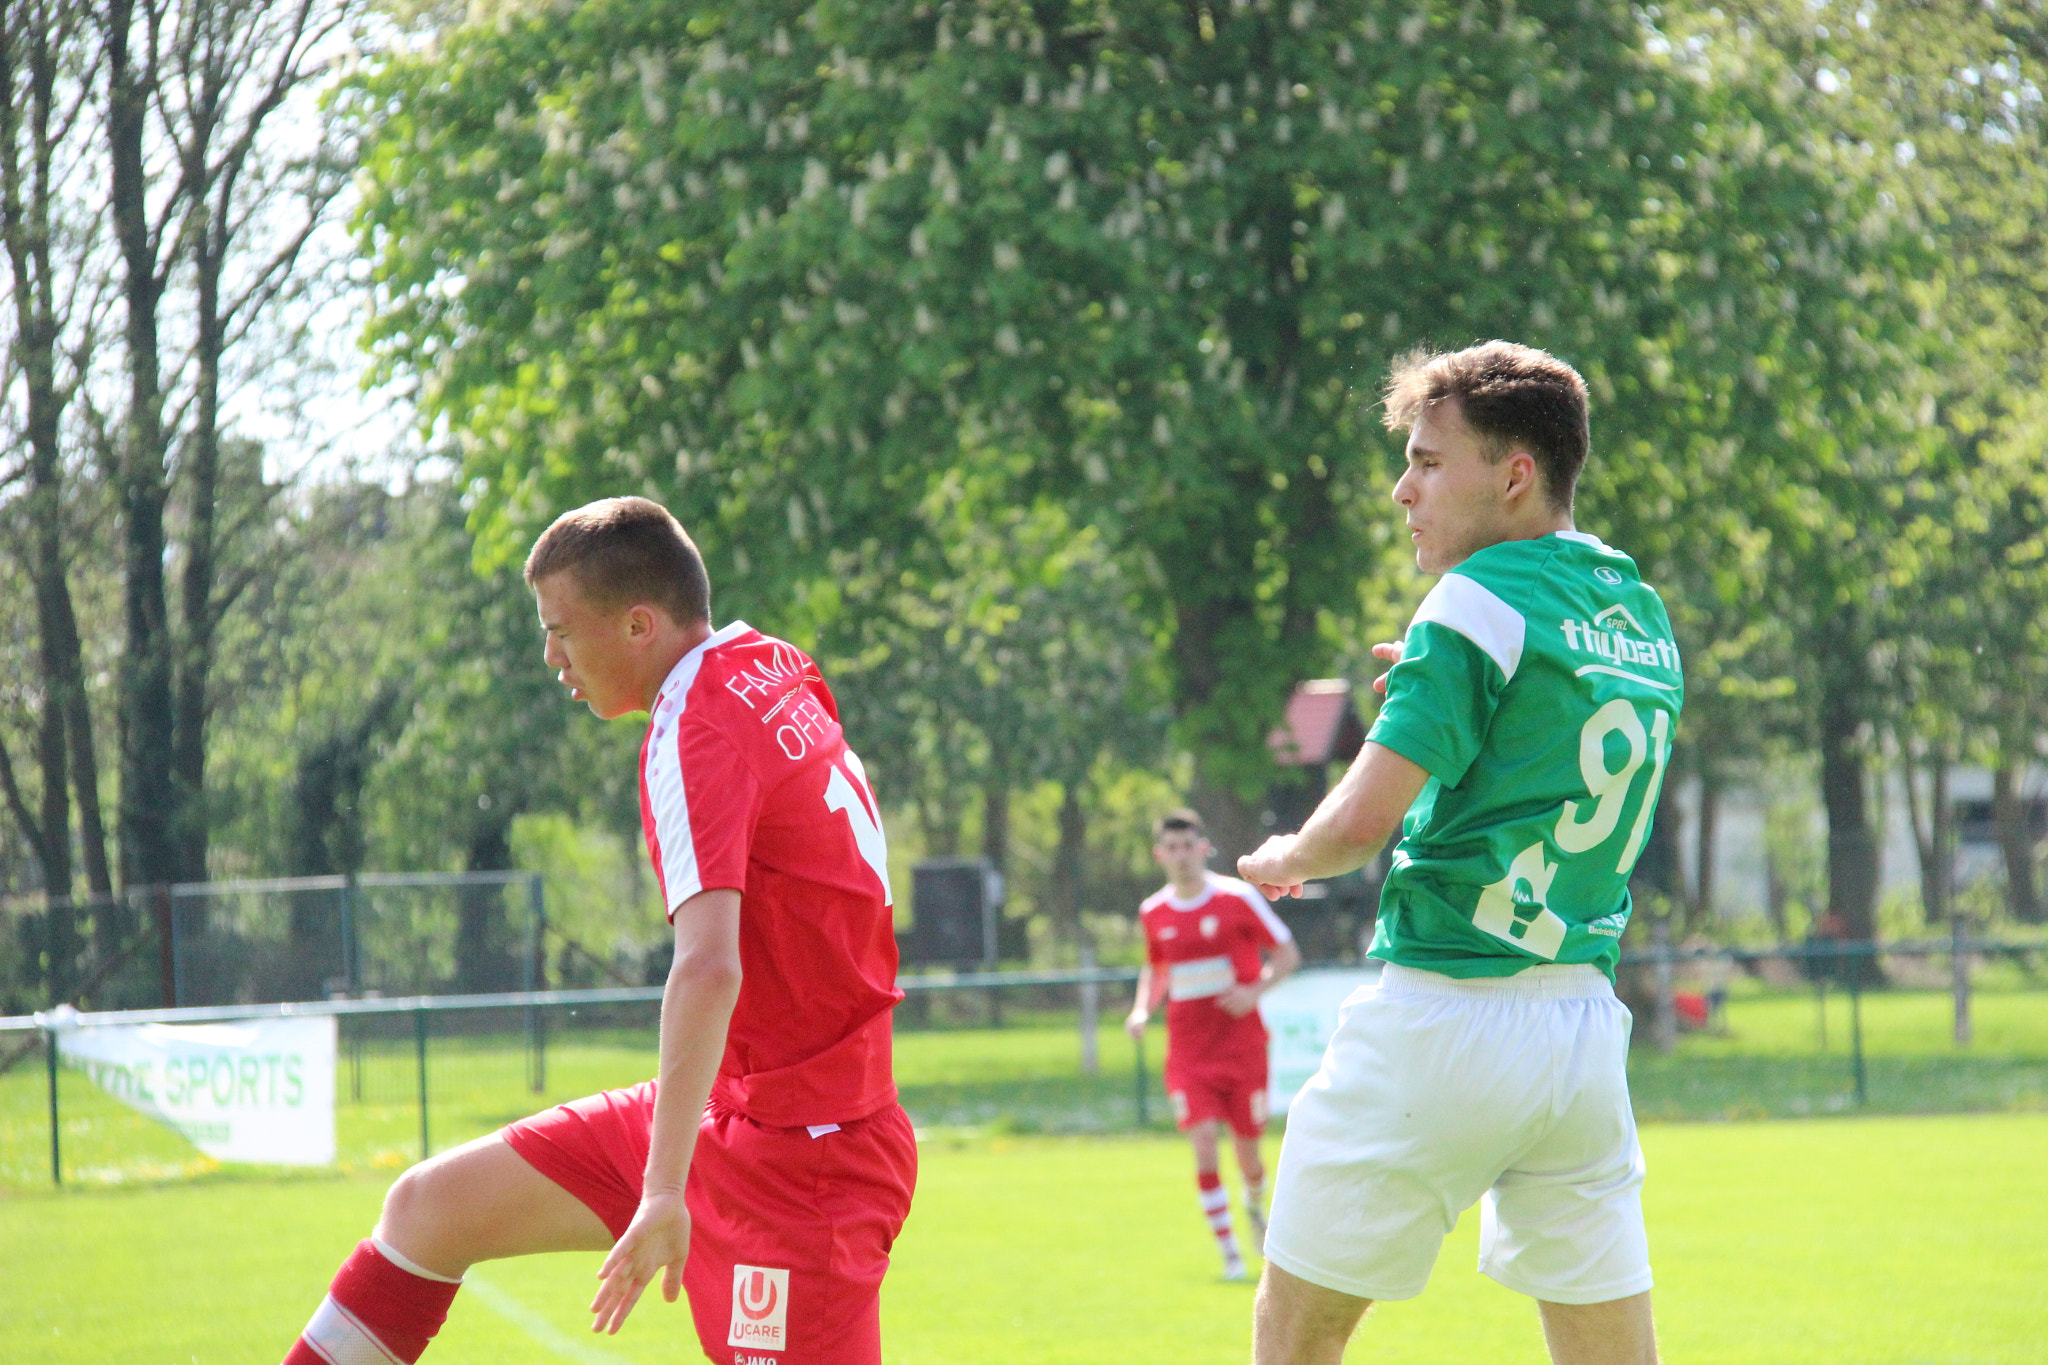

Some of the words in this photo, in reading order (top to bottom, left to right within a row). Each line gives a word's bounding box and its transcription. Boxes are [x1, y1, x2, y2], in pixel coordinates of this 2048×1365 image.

[1606, 618, 1628, 631] SPRL
[1555, 698, 1670, 874] 91
[164, 1053, 303, 1108] SPORTS
